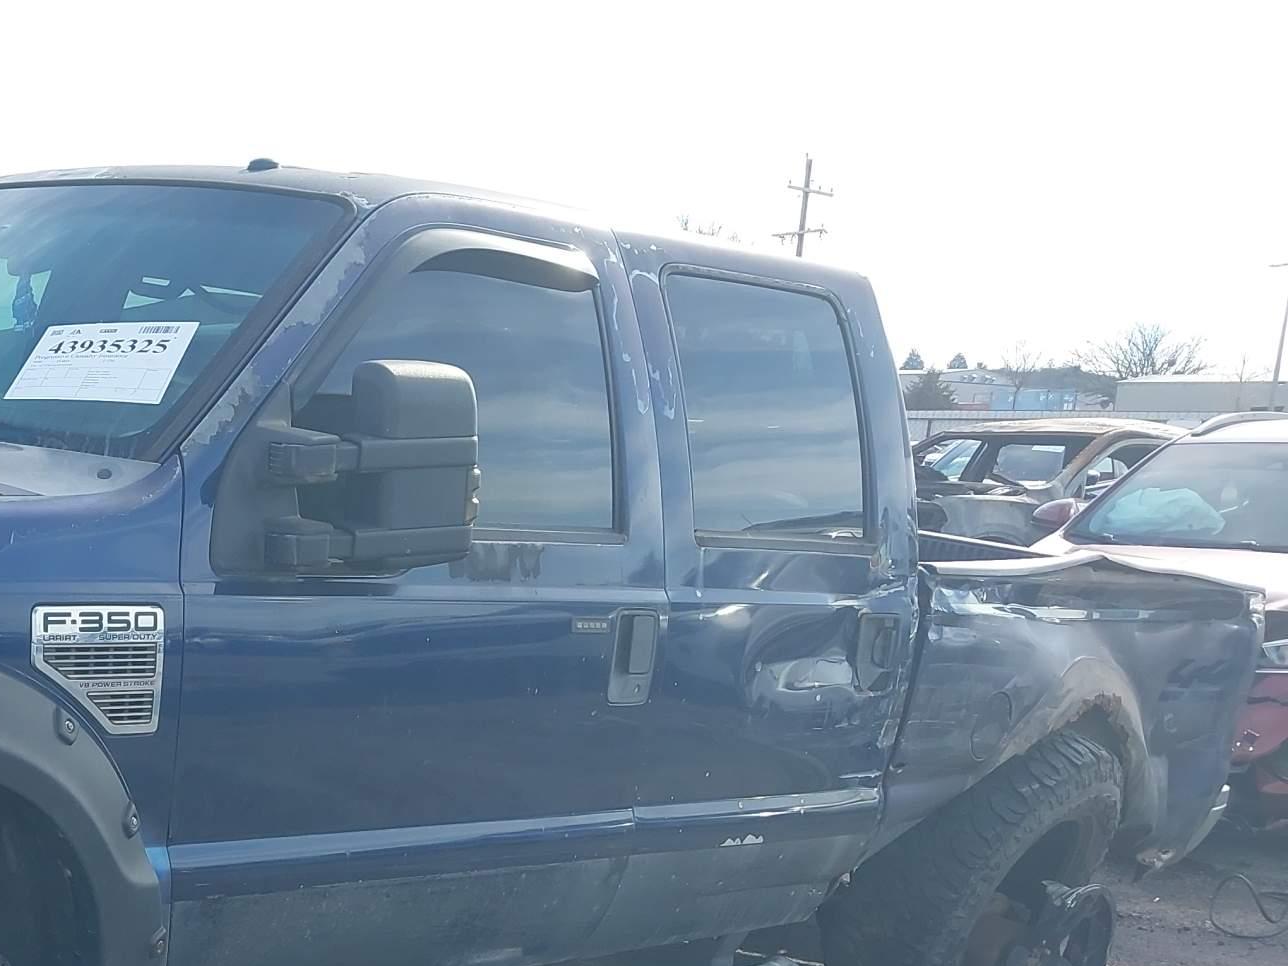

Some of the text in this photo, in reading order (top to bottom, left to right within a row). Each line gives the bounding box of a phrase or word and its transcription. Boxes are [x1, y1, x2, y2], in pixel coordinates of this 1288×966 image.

[48, 338, 171, 354] 43935325
[42, 634, 78, 642] LARIAT
[98, 633, 130, 641] SUPER
